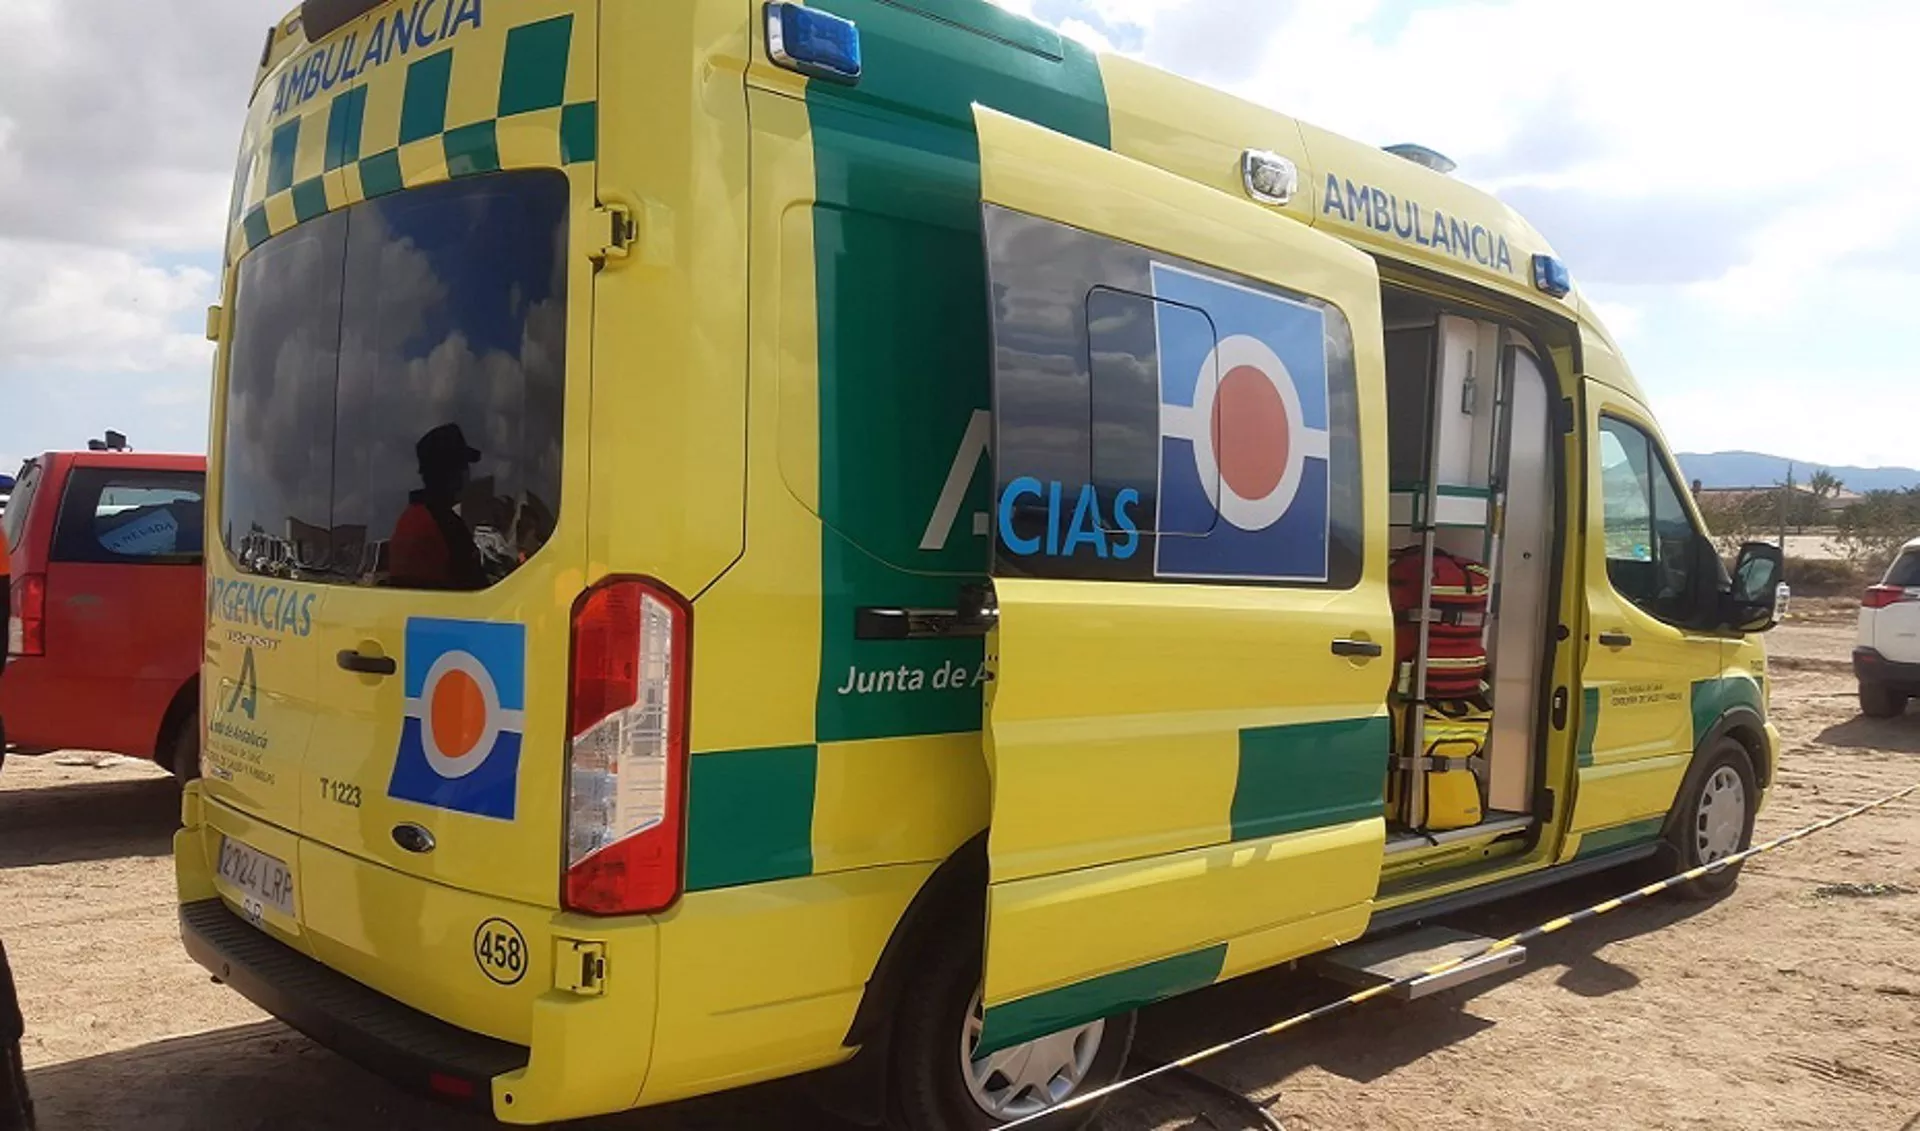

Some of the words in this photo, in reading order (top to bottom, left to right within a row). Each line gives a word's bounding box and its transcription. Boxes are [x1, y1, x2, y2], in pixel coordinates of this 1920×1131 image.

[269, 0, 482, 119] AMBULANCIA
[1322, 173, 1513, 273] AMBULANCIA
[998, 476, 1140, 560] CIAS
[838, 665, 925, 695] Junta
[932, 660, 967, 689] de
[480, 931, 520, 972] 458
